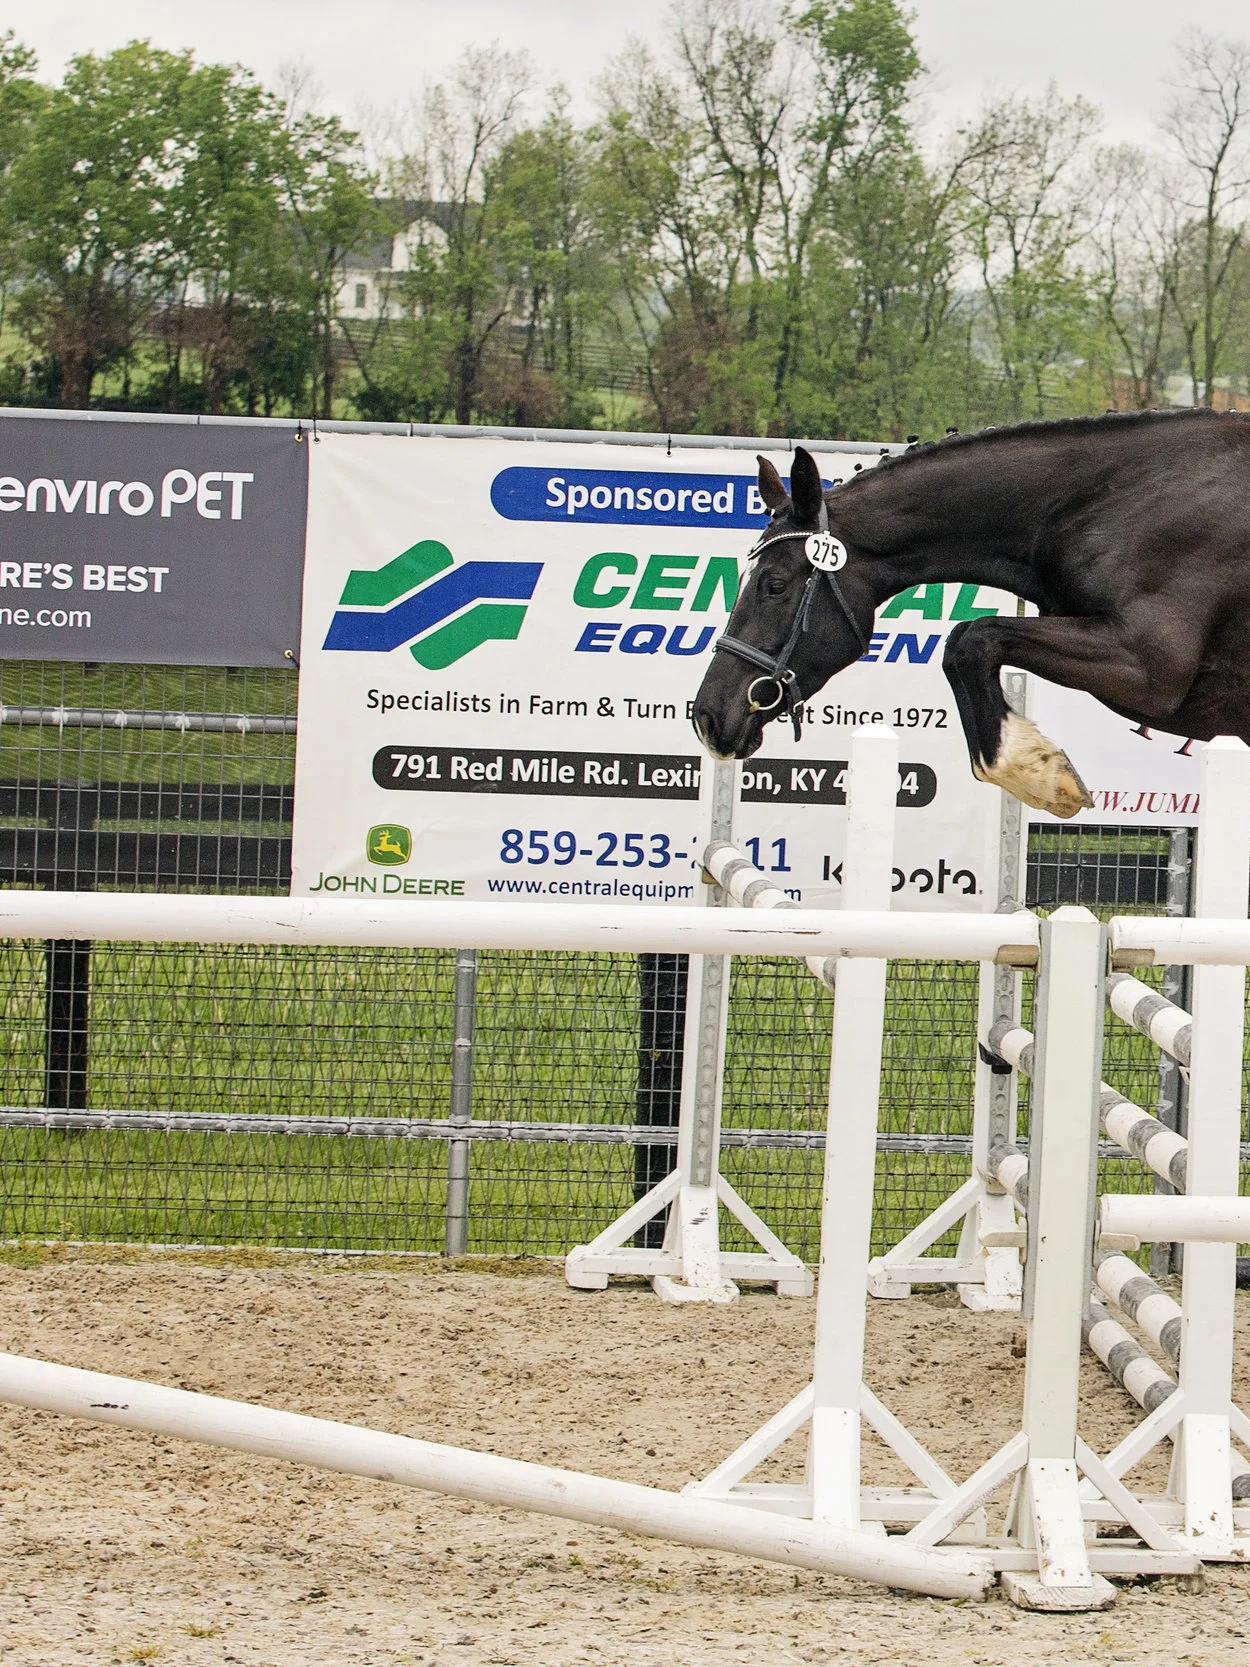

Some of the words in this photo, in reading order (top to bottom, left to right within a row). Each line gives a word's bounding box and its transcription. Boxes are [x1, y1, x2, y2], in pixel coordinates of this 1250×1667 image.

[160, 468, 254, 520] PET
[546, 477, 734, 515] Sponsored
[746, 485, 768, 515] B
[813, 540, 839, 567] 275
[83, 564, 169, 593] BEST
[573, 552, 999, 621] CENAL
[574, 622, 948, 664] EQUEN
[367, 689, 491, 714] Specialists
[500, 693, 520, 713] in
[530, 695, 587, 716] Farm
[597, 697, 615, 717] &
[624, 698, 676, 719] Turn
[822, 705, 884, 726] Since
[893, 708, 948, 729] 1972
[390, 754, 442, 779] 791
[450, 756, 503, 781] Red
[511, 758, 575, 783] Mile
[583, 760, 629, 785] Rd.
[637, 762, 782, 795] Lexion,
[790, 767, 827, 792] KY
[500, 828, 792, 872] 859-253-11
[309, 872, 377, 893] JOHN
[384, 874, 465, 896] DEERE
[488, 877, 802, 903] www.centralequipmm
